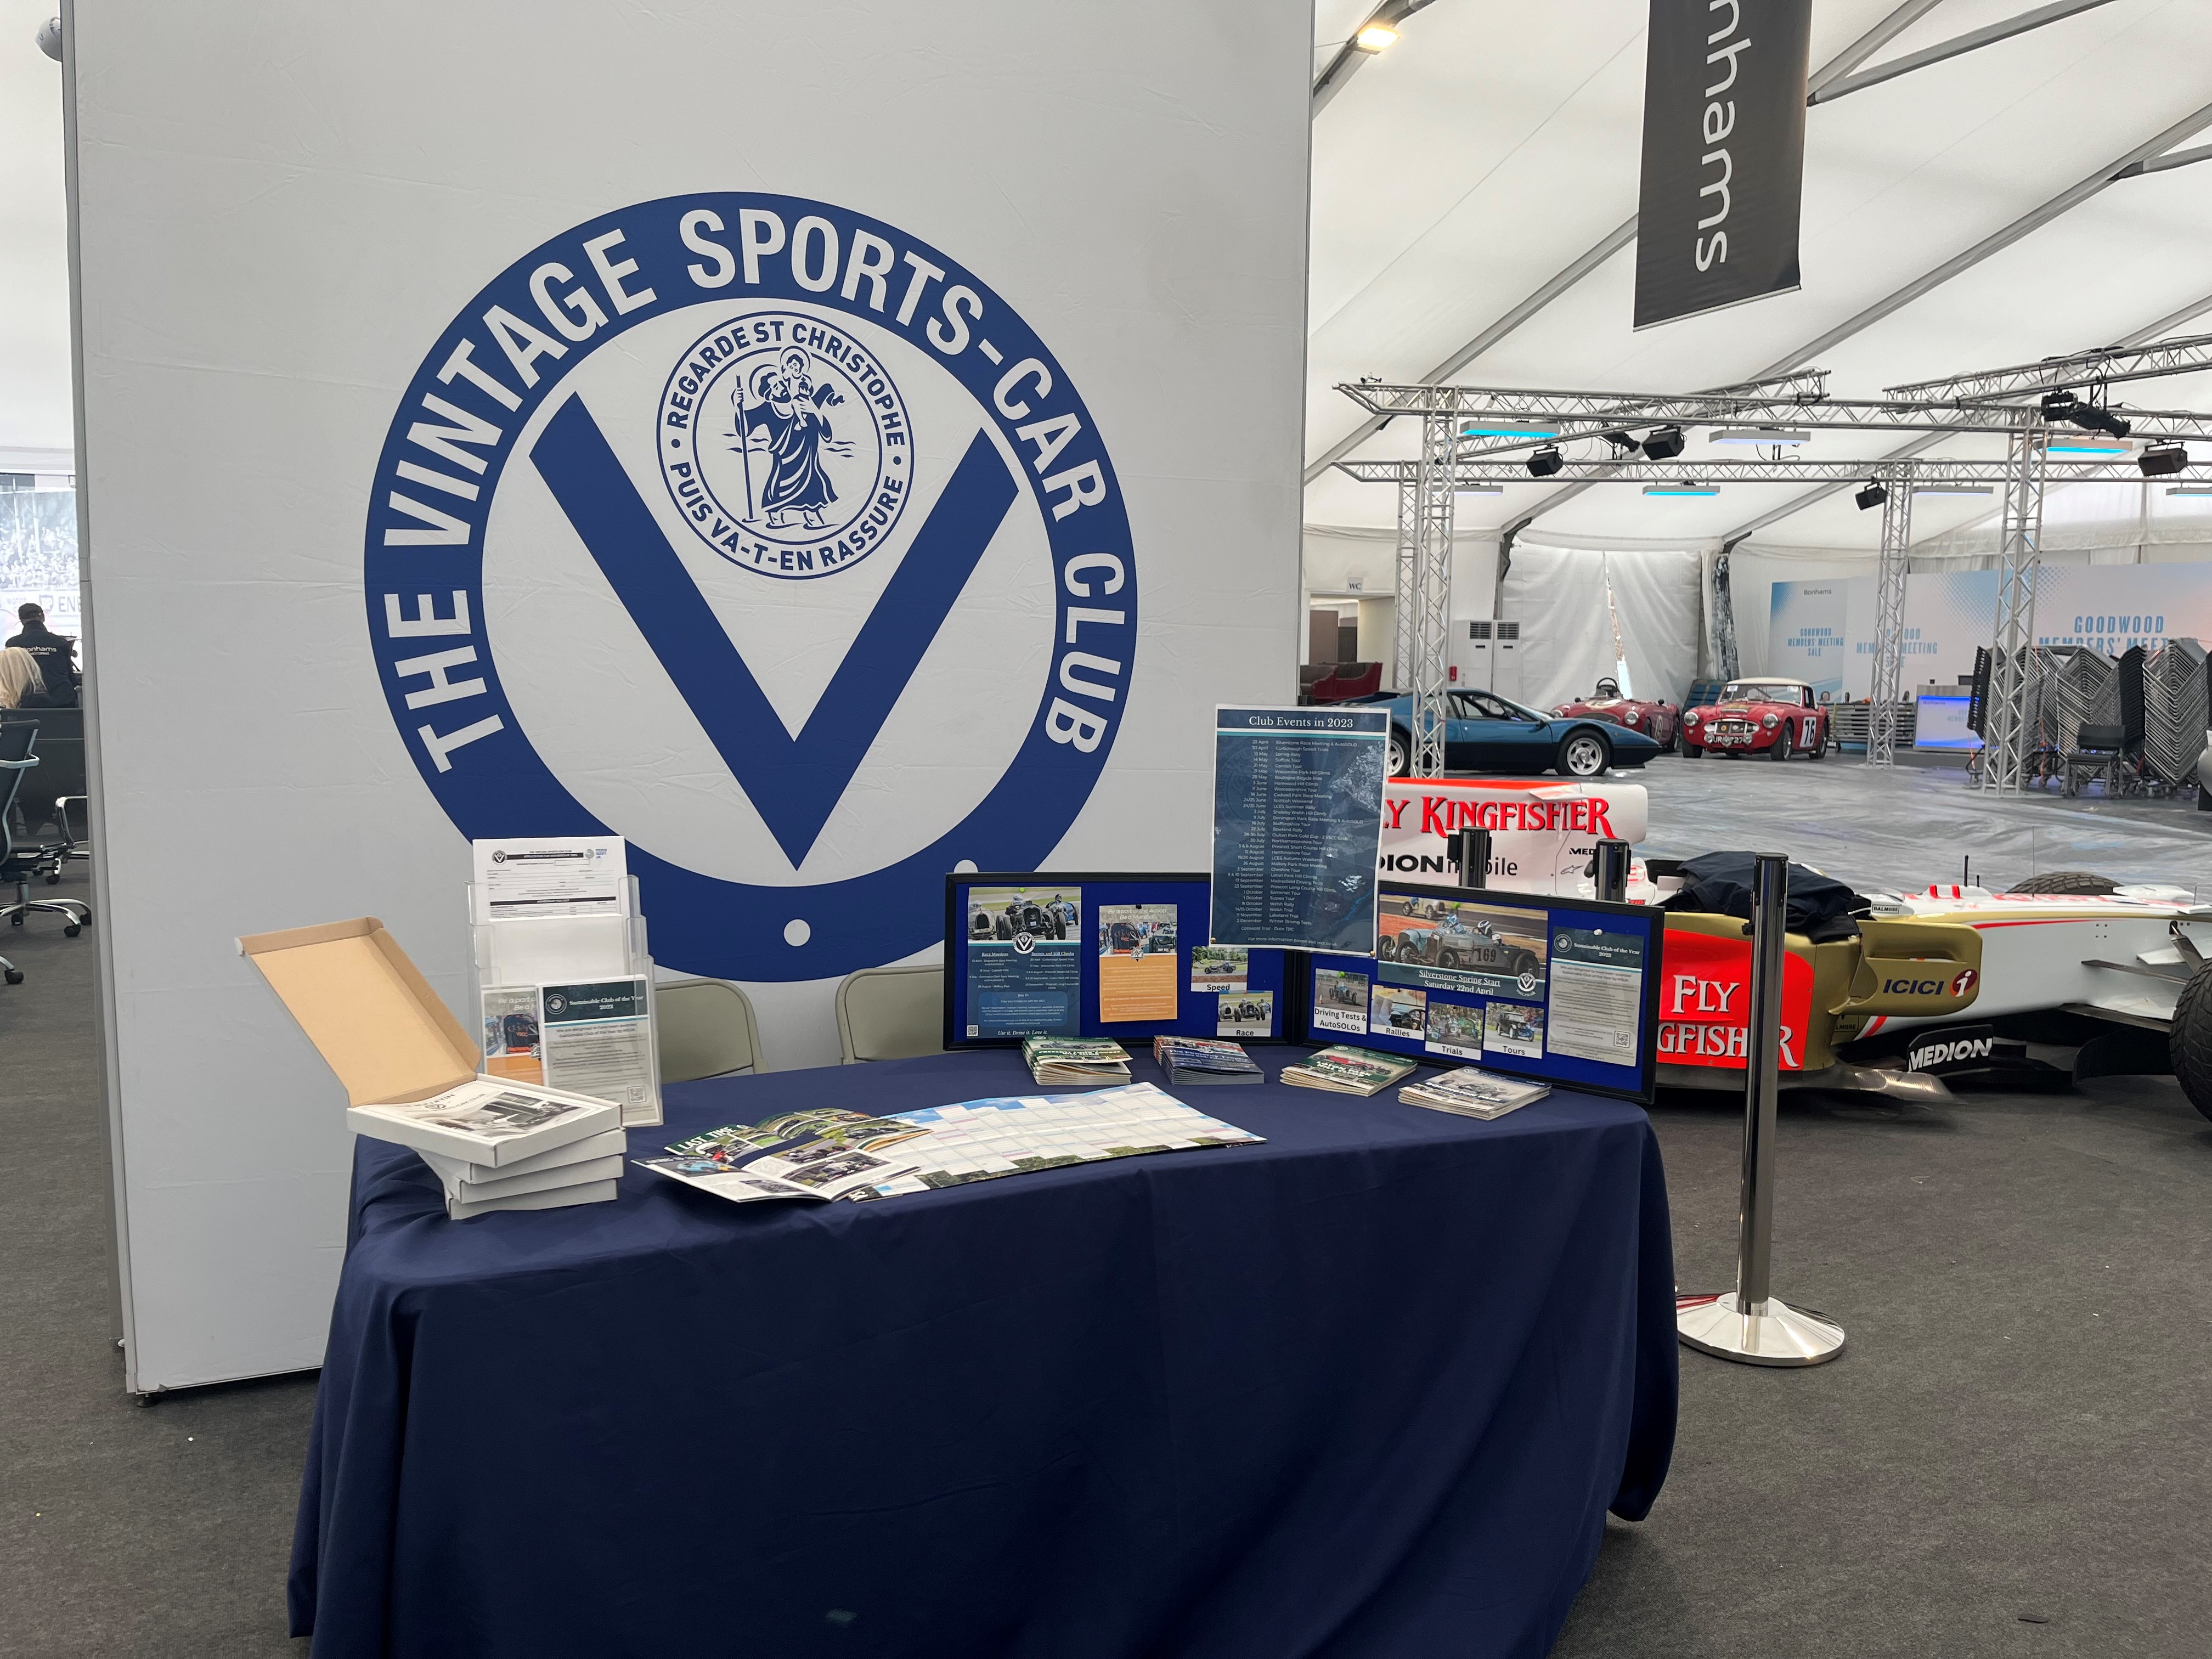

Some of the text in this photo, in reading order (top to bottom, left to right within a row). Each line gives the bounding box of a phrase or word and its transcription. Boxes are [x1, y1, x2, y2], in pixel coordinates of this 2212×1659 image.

[667, 320, 905, 447] REGARDE ST CHRISTOPHE
[384, 208, 1125, 774] THE VINTAGE SPORTS-CAR CLUB
[670, 461, 904, 571] PUIS VA-T-EN RASSURE
[2074, 615, 2164, 634] GOODWOOD
[1799, 628, 1832, 637] GOODWOOD
[1818, 637, 1844, 647] MEETING
[1901, 642, 1938, 654] MEETING
[1807, 647, 1822, 657] SALE
[1249, 716, 1353, 728] Club Events in 2023
[1804, 718, 1815, 746] 76
[1420, 796, 1618, 839] KINGFISHER
[1573, 943, 1601, 951] Sustainable
[1476, 947, 1497, 963] 169
[1419, 969, 1501, 987] Silverstone Spring Start
[1206, 984, 1231, 992] Speed
[1424, 980, 1494, 995] Saturday 22nd April
[1671, 974, 1740, 1014] FLY
[1883, 979, 1945, 995] ICICI
[1314, 1008, 1340, 1019] Driving
[1341, 1012, 1360, 1021] Tests
[1319, 1019, 1361, 1032] AutoSOLOs
[1386, 1028, 1410, 1037] Rallies
[1442, 1046, 1463, 1056] Trials
[1503, 1046, 1526, 1056] Tours
[1657, 1022, 1799, 1068] GFISHR
[1908, 1037, 1993, 1073] MEDION
[677, 1136, 707, 1150] LAST
[705, 1126, 737, 1138] TIME
